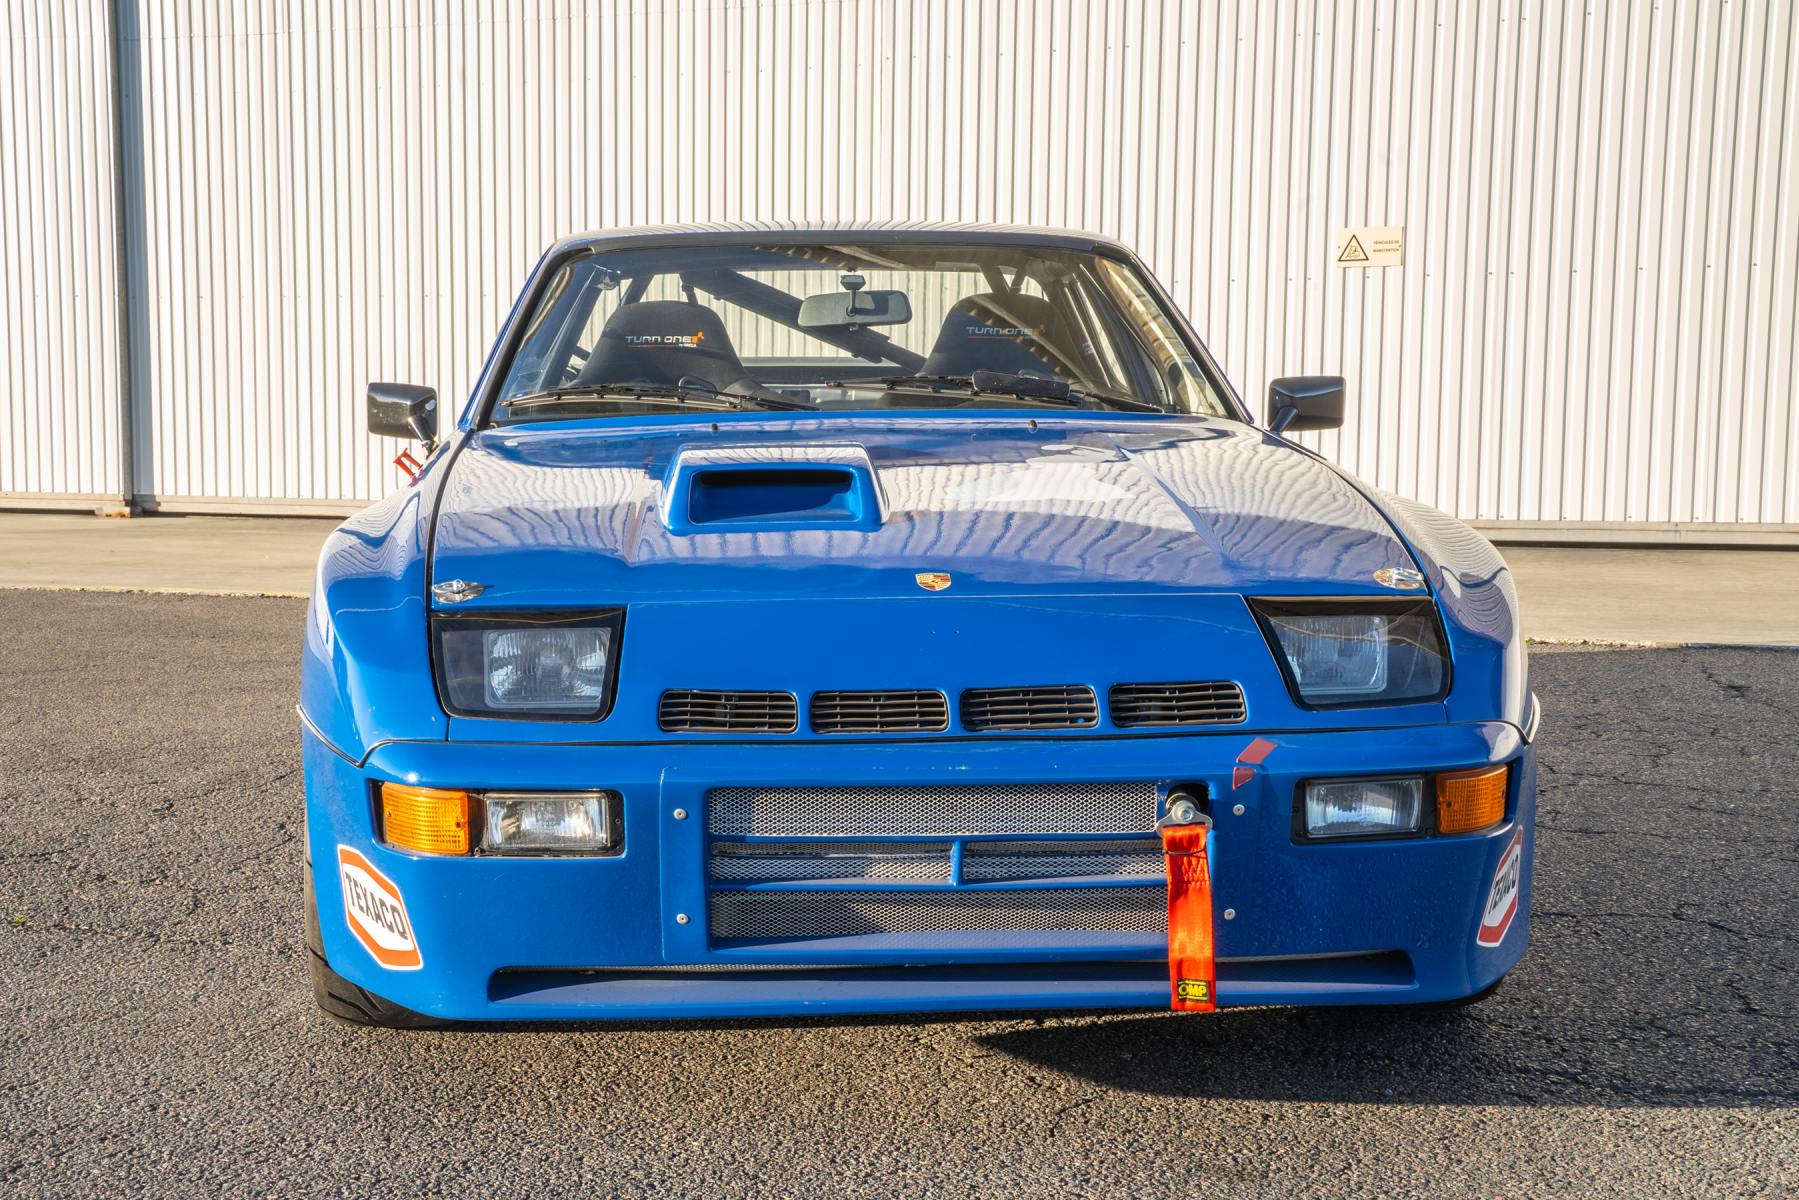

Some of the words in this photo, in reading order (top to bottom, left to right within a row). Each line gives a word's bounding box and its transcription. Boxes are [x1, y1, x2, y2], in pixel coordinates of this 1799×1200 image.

[624, 335, 661, 343] TURN
[664, 335, 692, 343] ONE
[345, 871, 408, 941] TEXACO
[1178, 983, 1207, 997] OMP
